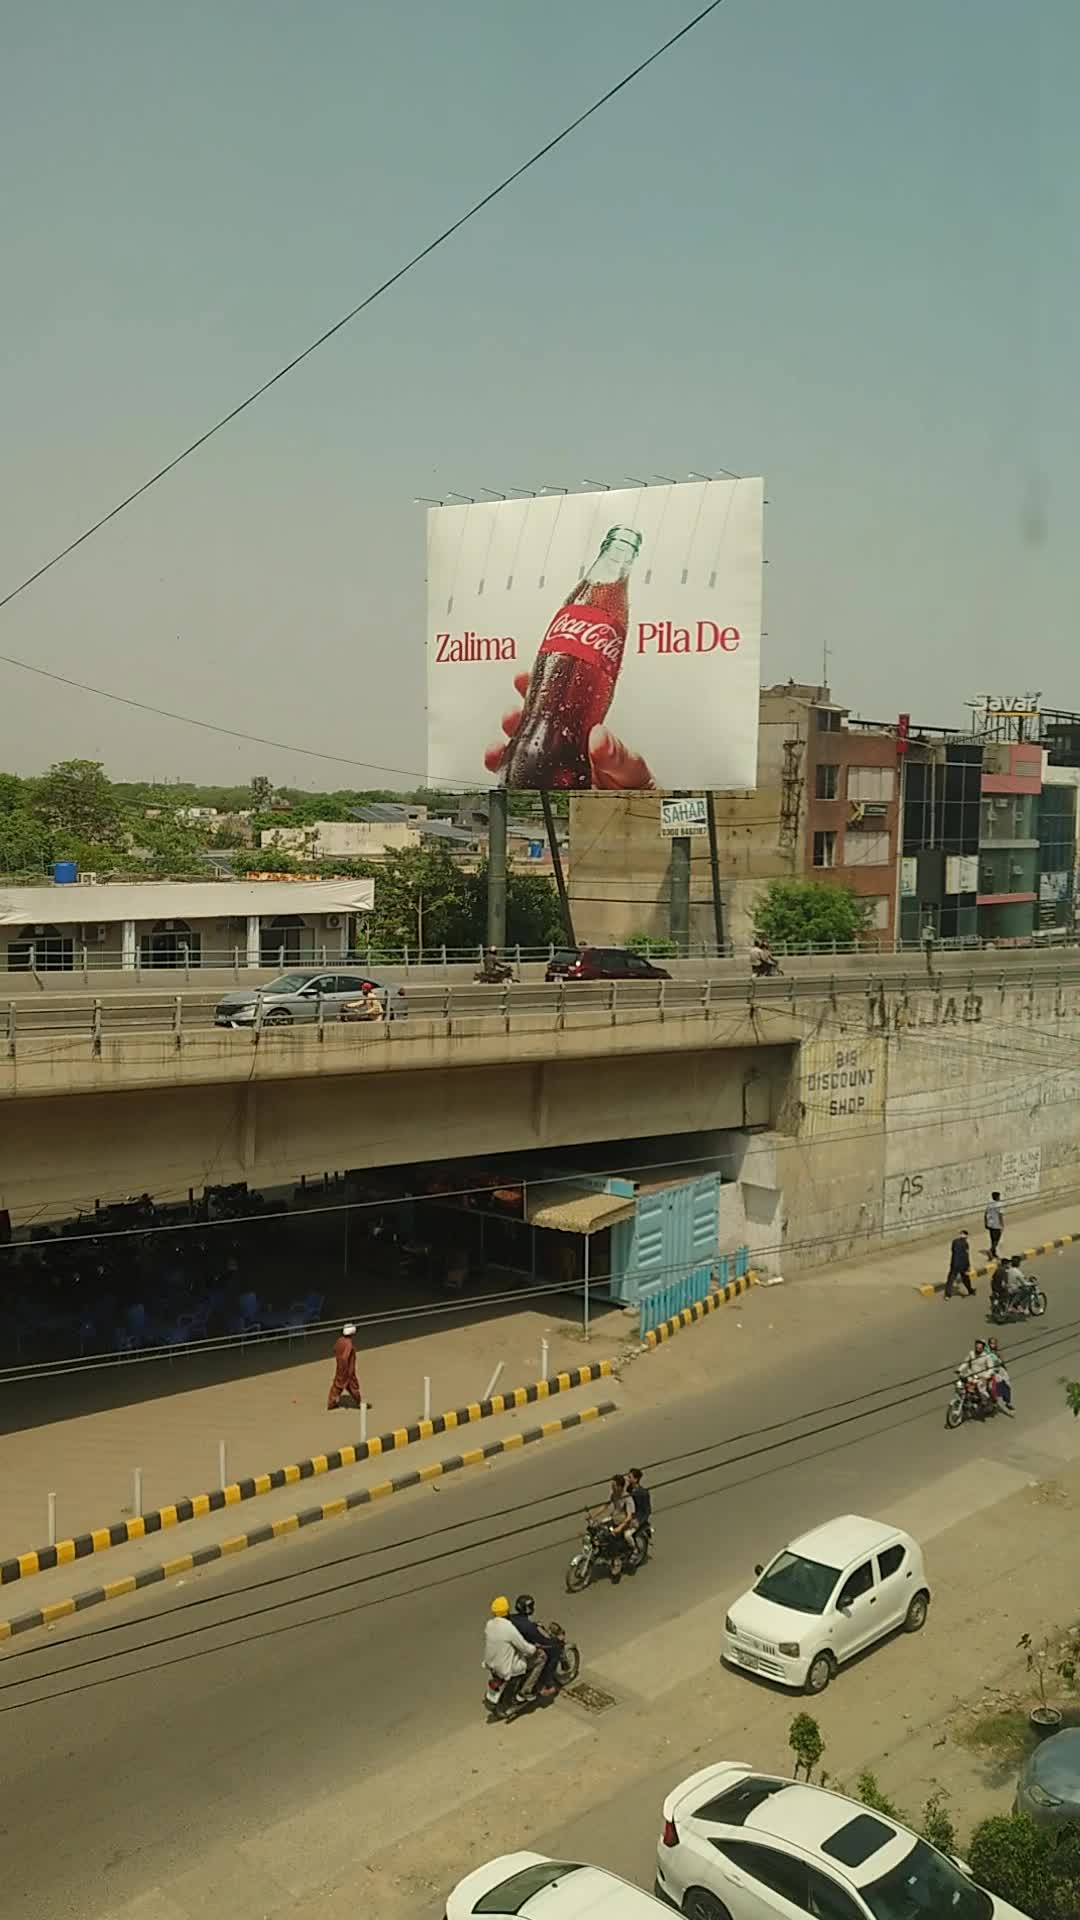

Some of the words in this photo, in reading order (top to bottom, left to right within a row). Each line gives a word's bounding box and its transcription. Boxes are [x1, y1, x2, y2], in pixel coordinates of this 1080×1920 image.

[436, 632, 517, 662] Zalima
[637, 621, 690, 654] Pila
[696, 621, 741, 652] De
[663, 800, 706, 824] SAHAR
[807, 1069, 875, 1091] DISCOUNT
[829, 1096, 865, 1116] SHOP
